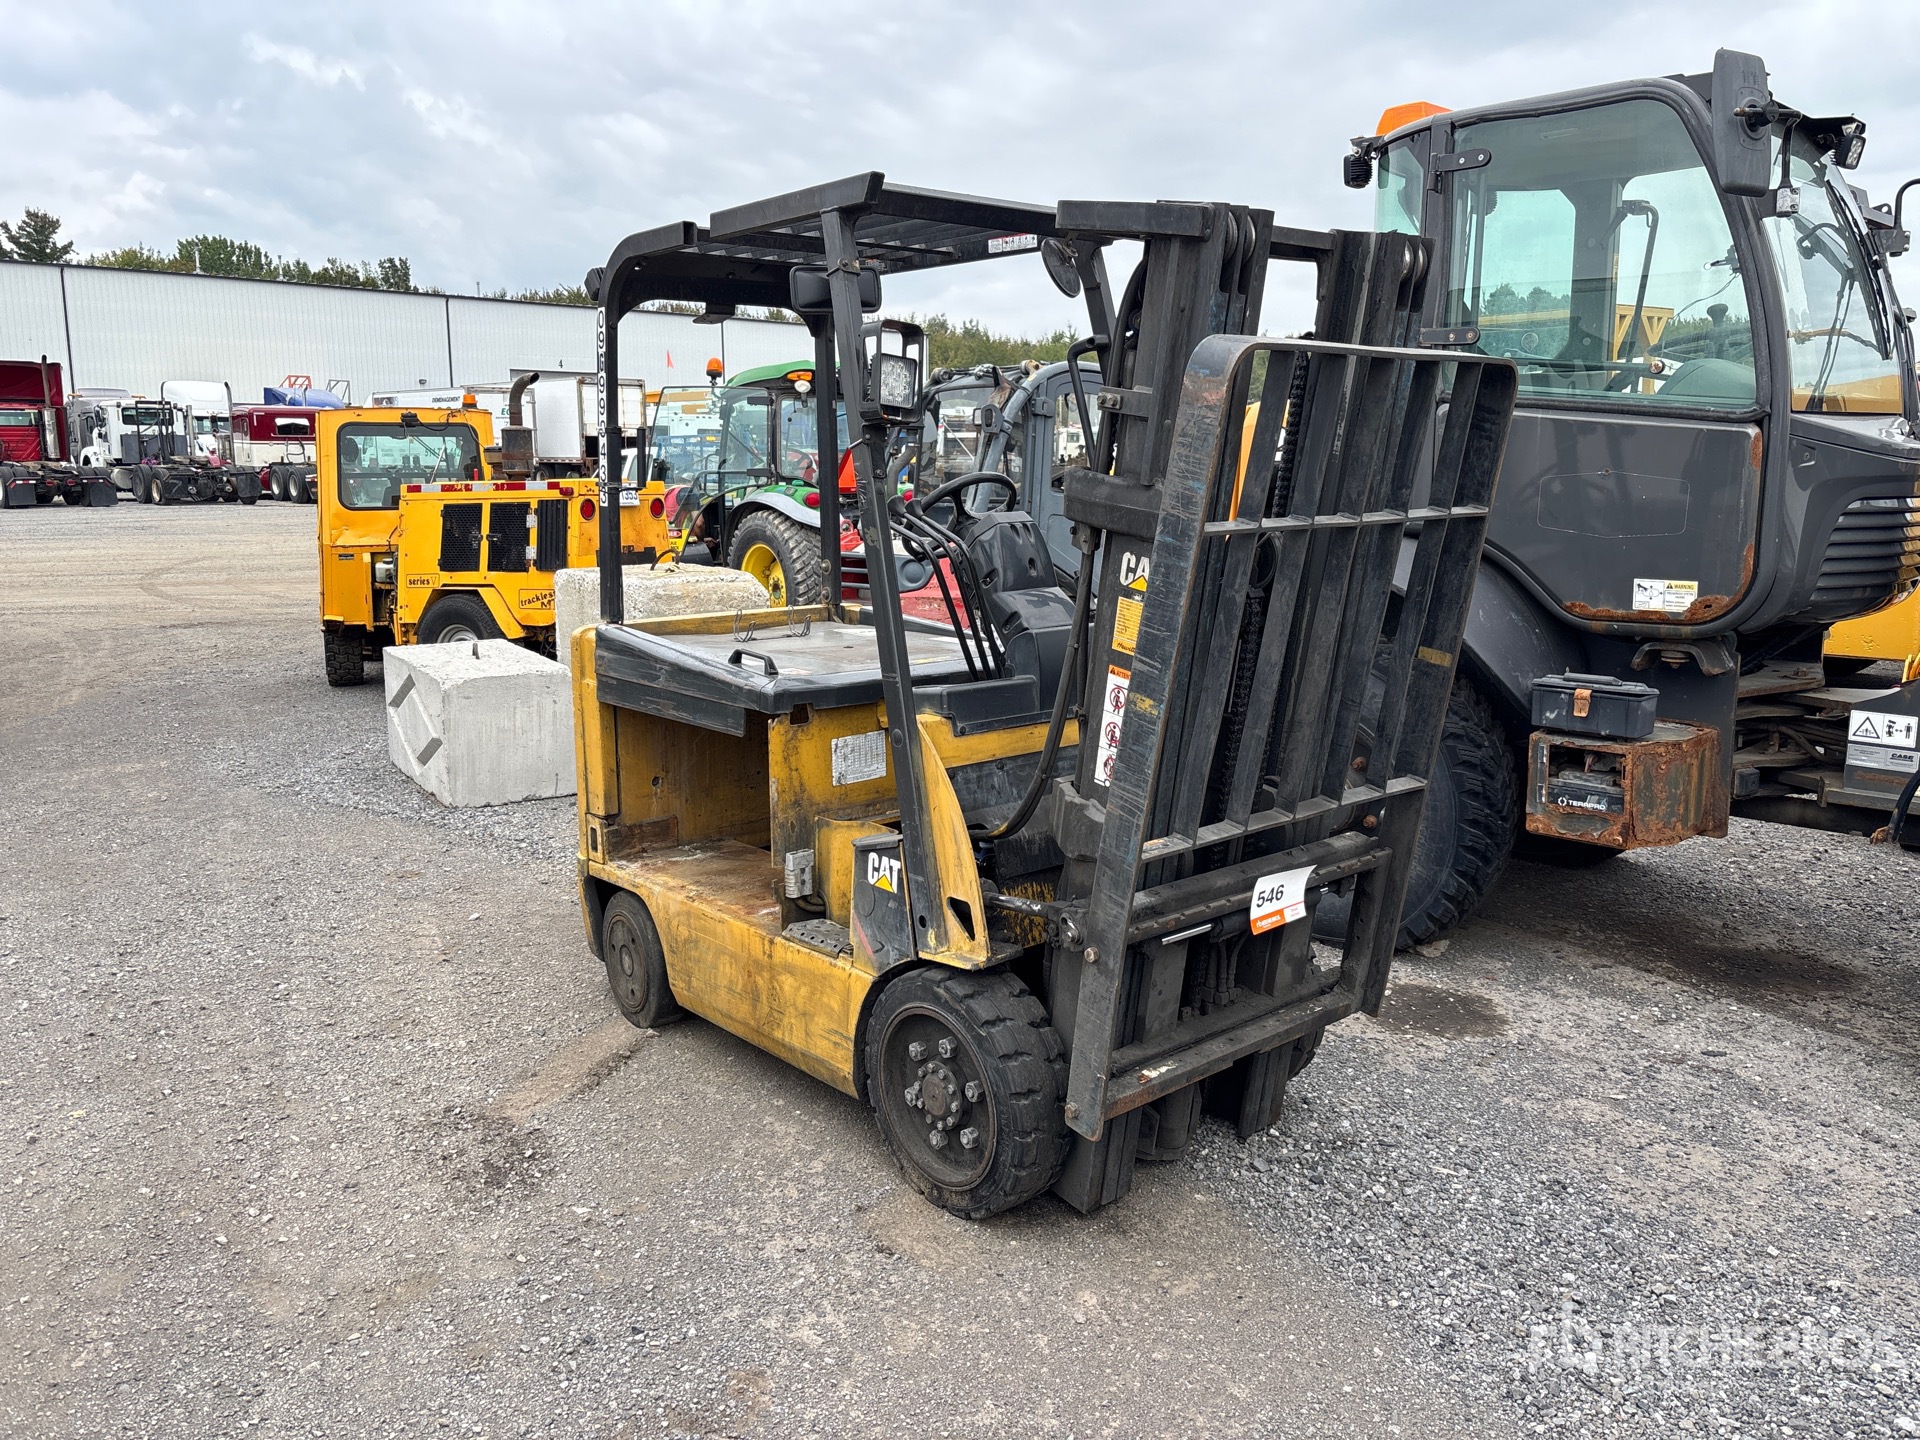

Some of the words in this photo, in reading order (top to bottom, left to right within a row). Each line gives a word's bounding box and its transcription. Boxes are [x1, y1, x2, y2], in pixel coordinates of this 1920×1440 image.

[558, 359, 564, 369] 4
[408, 577, 430, 585] series
[430, 576, 437, 586] V
[1891, 752, 1915, 760] CASE
[867, 852, 901, 894] CAT
[1256, 884, 1285, 908] 546
